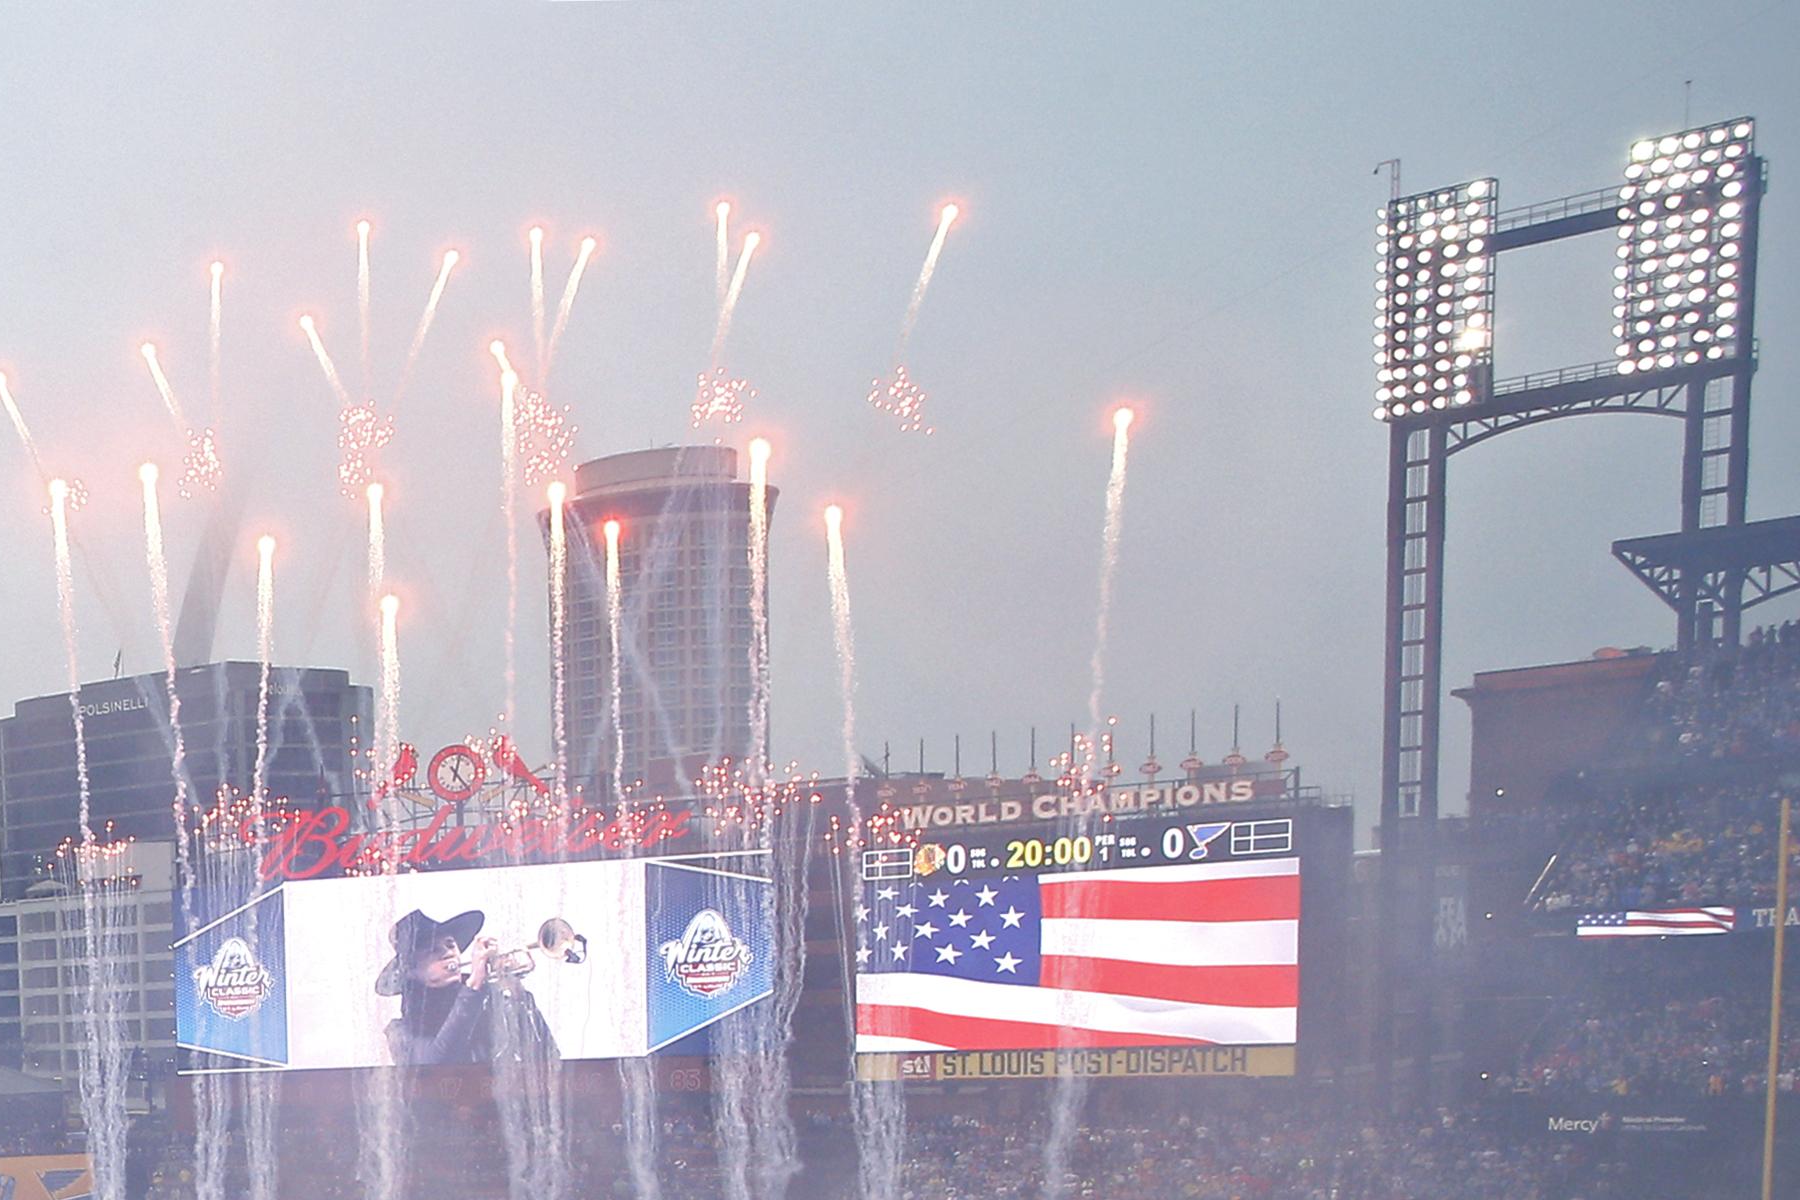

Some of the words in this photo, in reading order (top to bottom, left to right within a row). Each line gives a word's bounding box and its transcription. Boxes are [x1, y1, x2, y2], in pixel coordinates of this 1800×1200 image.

[80, 698, 149, 716] POLSINELLI
[902, 803, 1022, 829] WORLD
[1032, 780, 1255, 818] CHAMPIONS
[240, 798, 691, 882] Budweiser
[946, 844, 967, 875] 0
[1006, 836, 1092, 868] 20:00
[1095, 833, 1115, 846] PER
[1162, 828, 1184, 860] 0
[1099, 848, 1109, 861] 1
[660, 937, 750, 980] Winter
[681, 961, 736, 974] CLASSIC
[194, 962, 269, 1000] Winter
[211, 985, 260, 997] CLASSIC
[943, 1051, 974, 1076] ST.
[979, 1049, 1045, 1076] LOUIS
[1053, 1047, 1247, 1075] POST-DISPATCH
[671, 1069, 701, 1090] 85
[1548, 1117, 1598, 1133] Mercy
